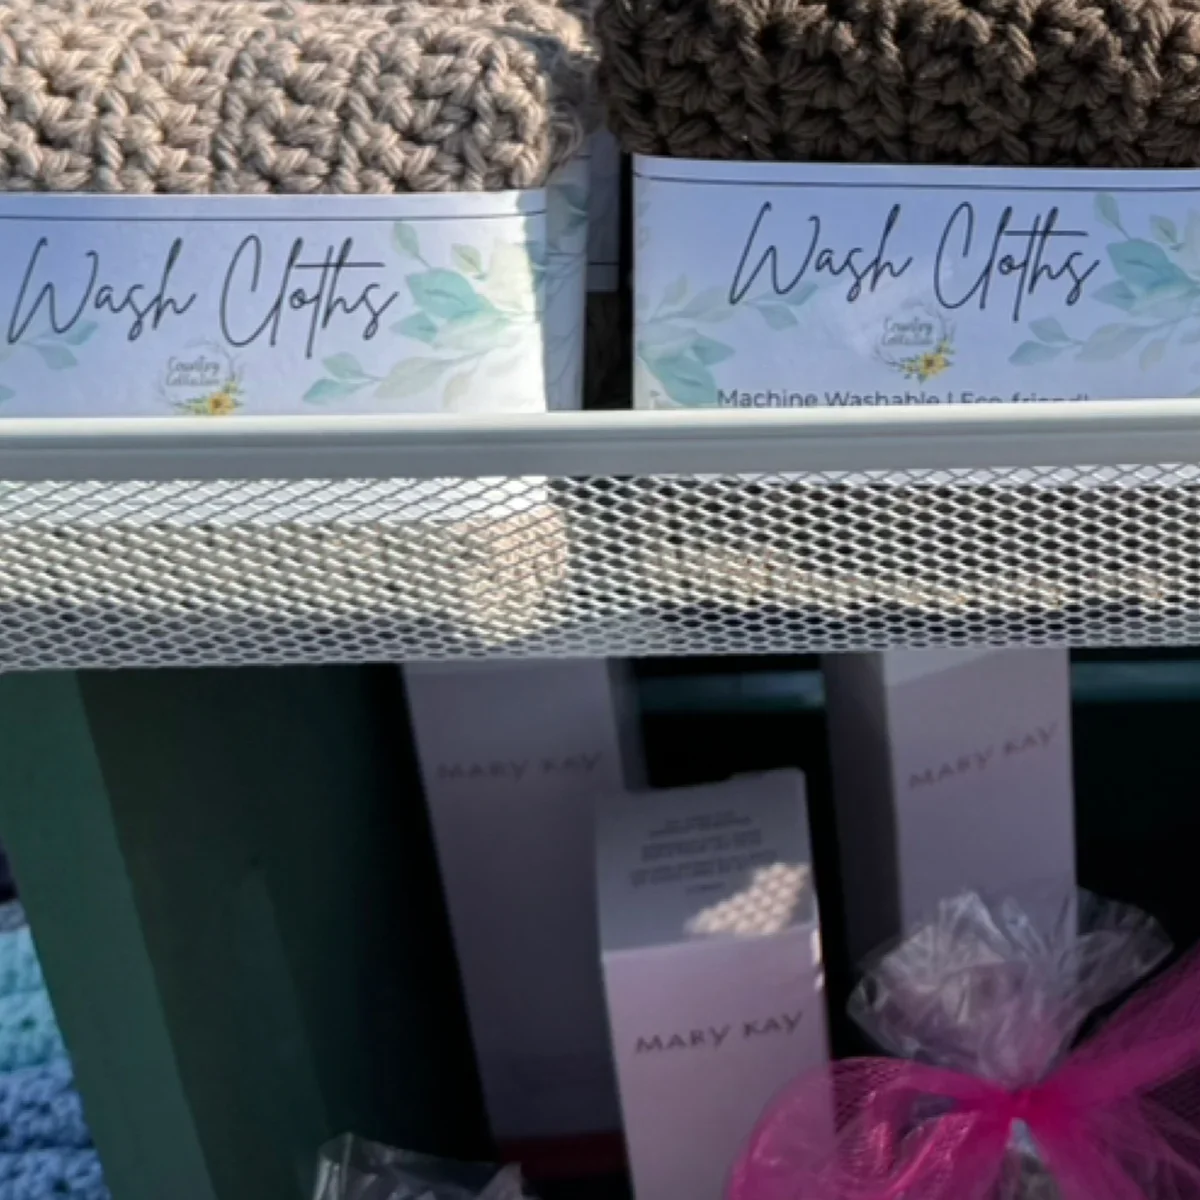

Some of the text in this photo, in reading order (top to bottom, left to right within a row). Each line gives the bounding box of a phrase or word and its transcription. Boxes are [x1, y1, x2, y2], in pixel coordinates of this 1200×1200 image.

[729, 201, 1100, 323] Wash Cloths
[7, 233, 400, 360] Wash Cloths
[717, 388, 819, 408] Machine
[436, 750, 604, 785] MARY KAY
[907, 721, 1059, 791] MARY KAY
[635, 1008, 804, 1055] MARY KAY
